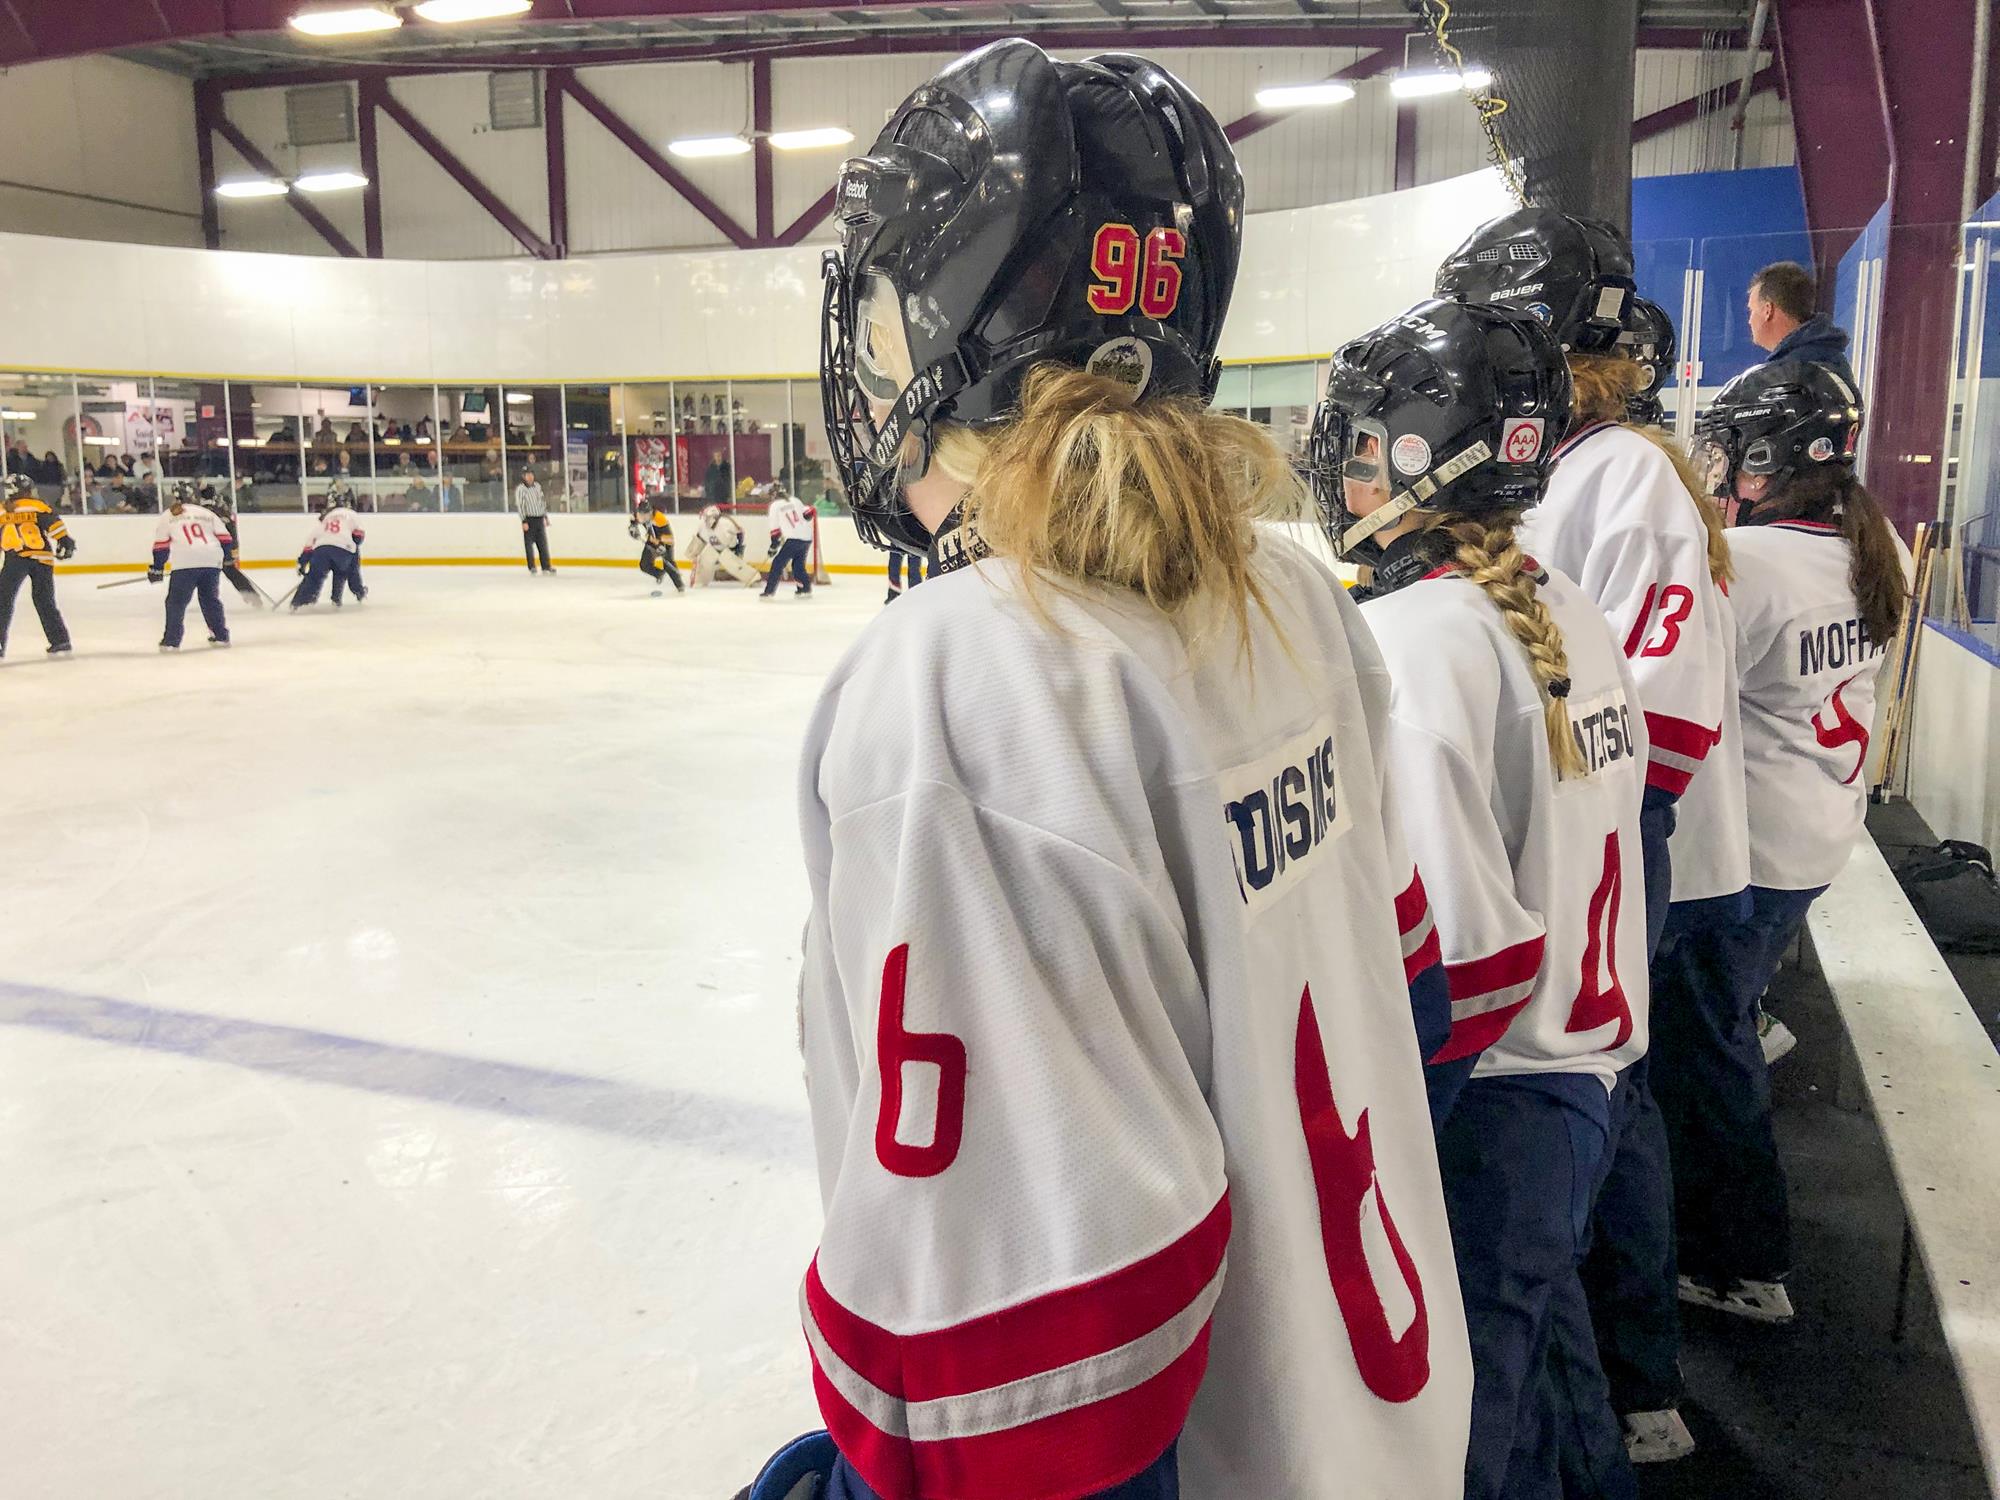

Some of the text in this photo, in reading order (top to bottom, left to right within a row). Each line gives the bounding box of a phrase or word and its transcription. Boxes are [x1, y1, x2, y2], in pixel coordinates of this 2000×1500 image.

[1087, 223, 1186, 319] 96
[1490, 282, 1544, 301] BAUER
[1512, 433, 1536, 446] AAA
[182, 522, 208, 545] 19
[1622, 582, 1694, 660] 13
[875, 943, 968, 1178] 6
